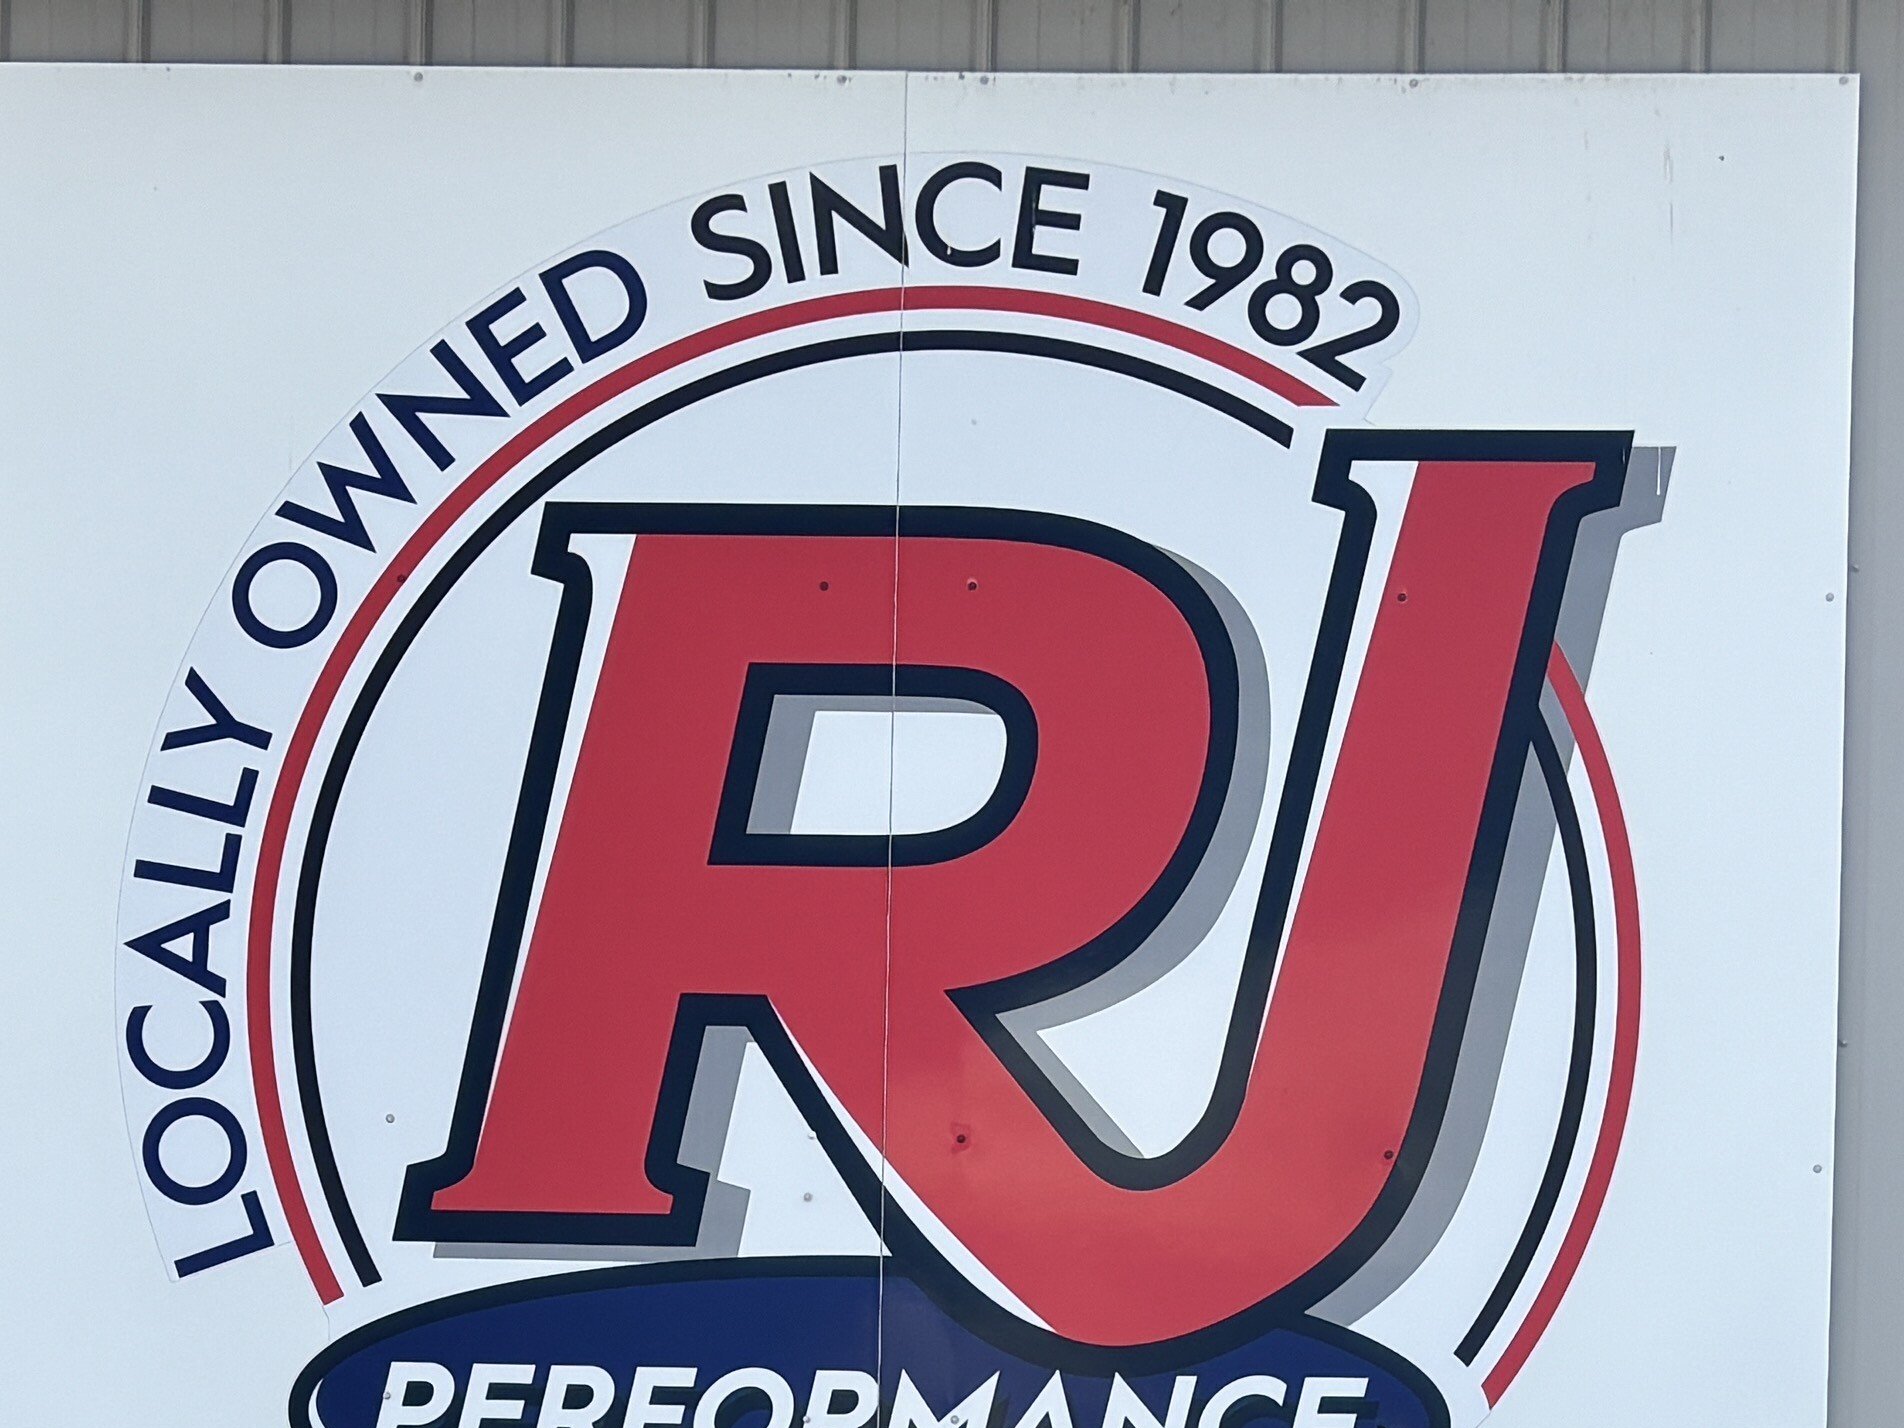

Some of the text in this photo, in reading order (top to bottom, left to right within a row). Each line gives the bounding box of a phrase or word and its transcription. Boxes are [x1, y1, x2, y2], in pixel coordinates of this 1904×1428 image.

[124, 161, 1400, 1279] LOCALLY OWNED SINCE 1982
[392, 429, 1636, 1362] RJ
